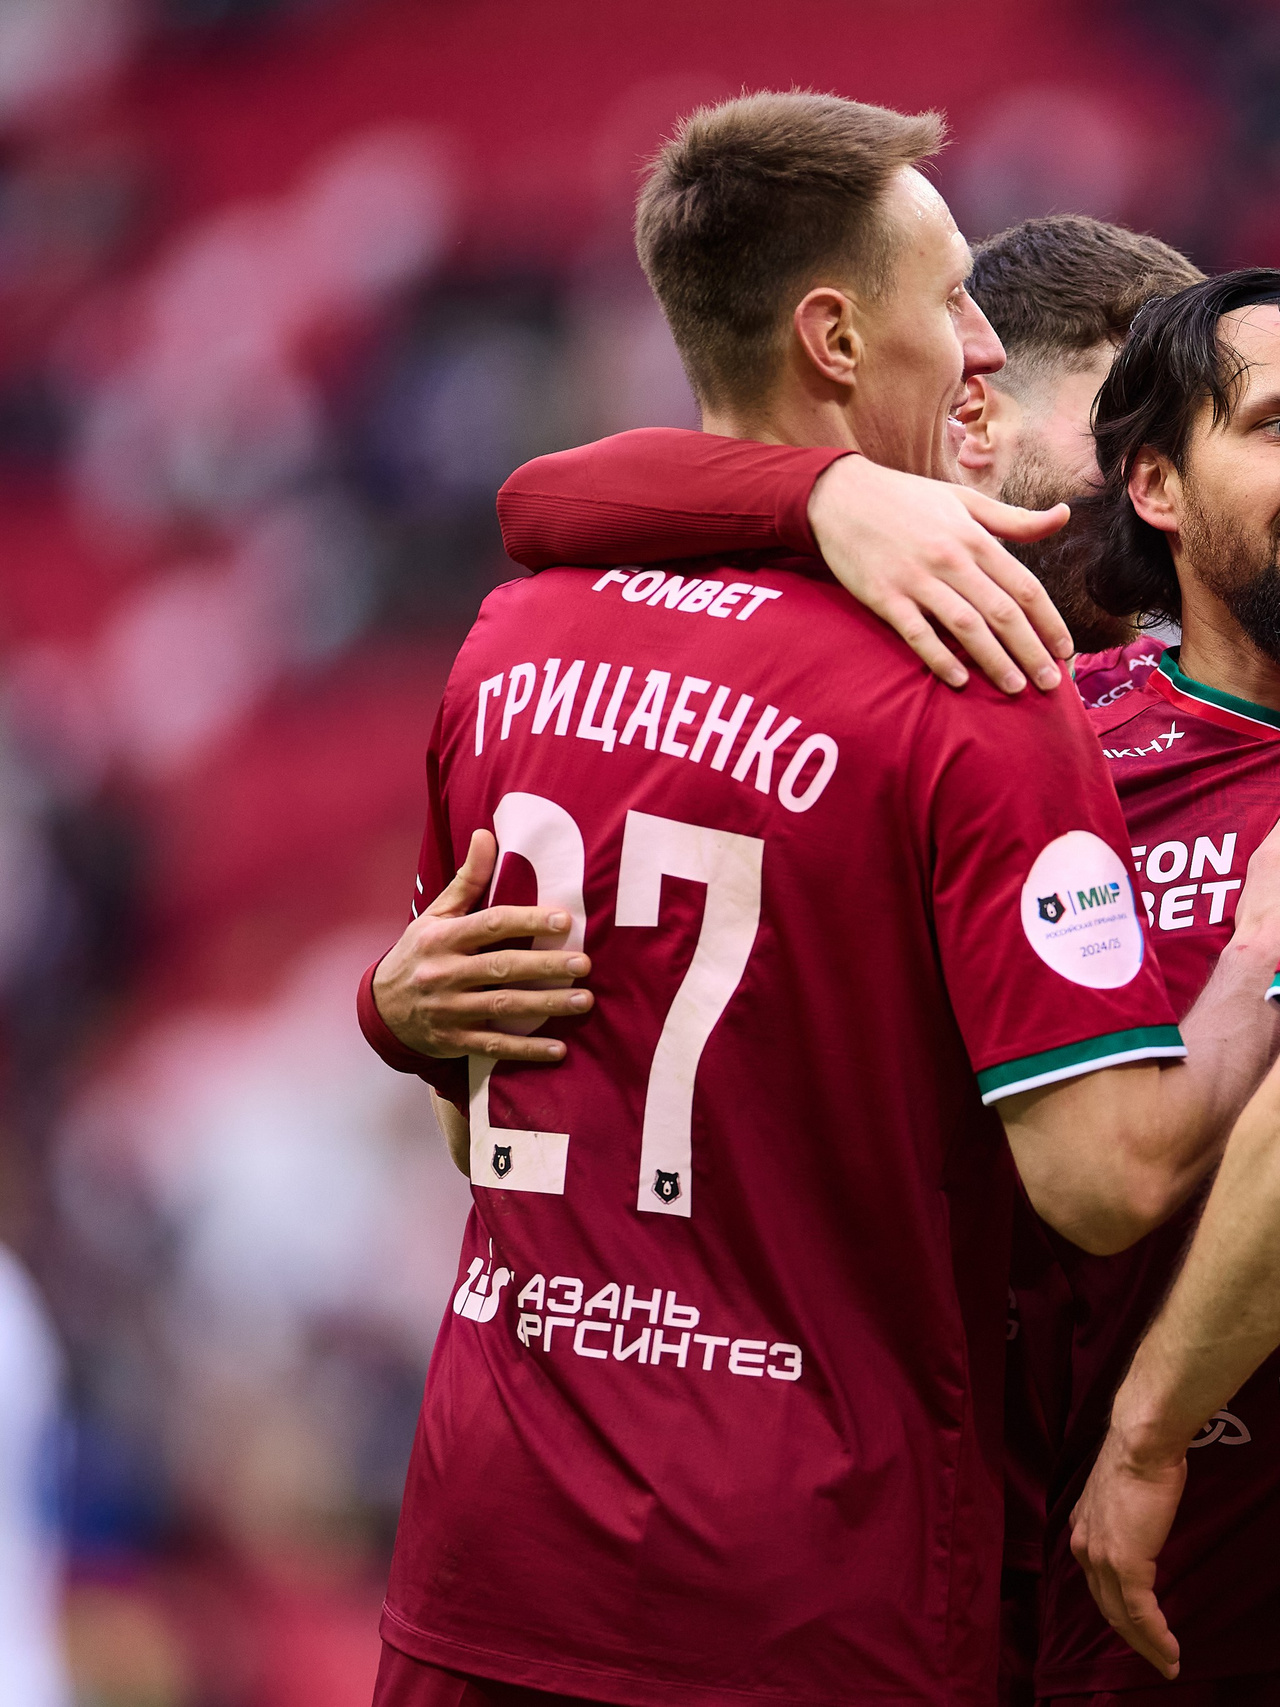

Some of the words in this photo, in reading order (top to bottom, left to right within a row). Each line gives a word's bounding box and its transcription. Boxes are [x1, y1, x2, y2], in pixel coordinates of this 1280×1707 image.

[591, 565, 783, 621] FONBET
[474, 657, 839, 813] ГРИЦАЕНКО
[1077, 882, 1120, 910] МИР
[469, 791, 765, 1218] 27
[511, 1271, 701, 1329] АЗАНЬ
